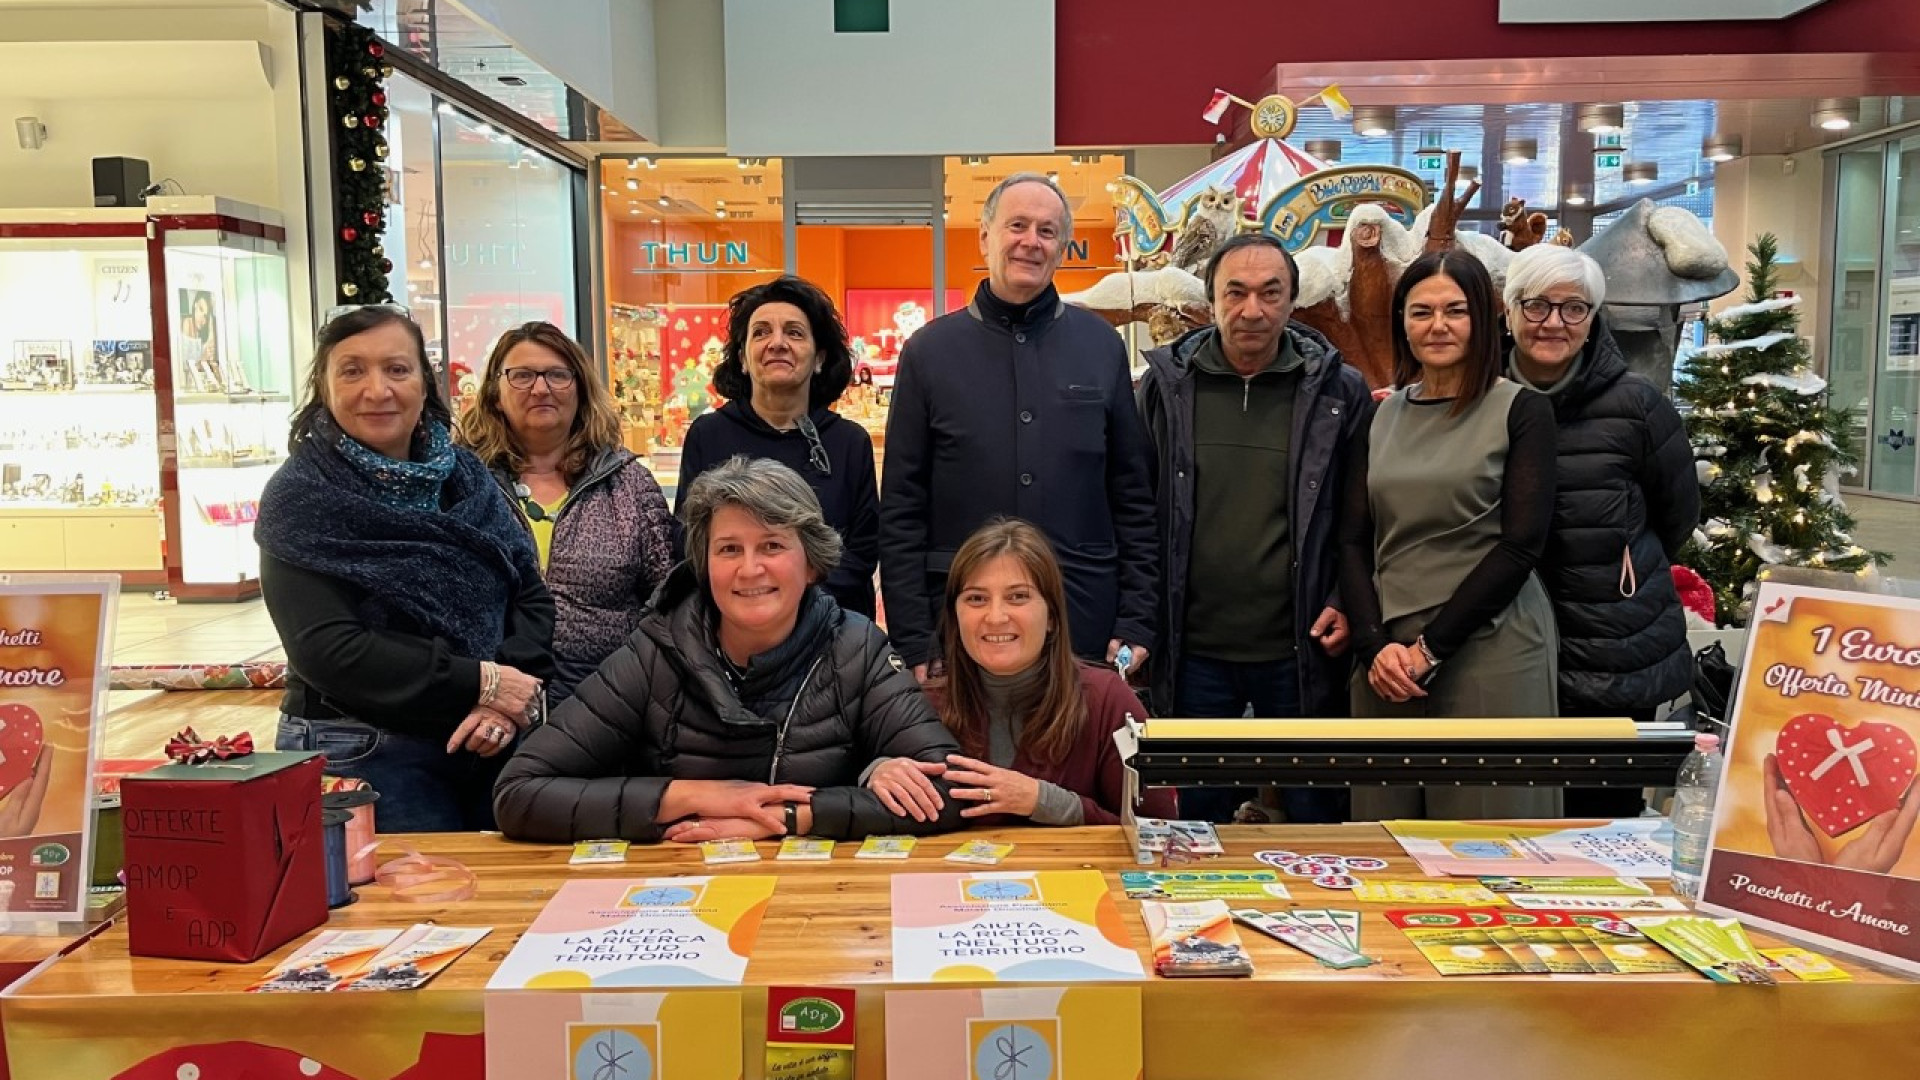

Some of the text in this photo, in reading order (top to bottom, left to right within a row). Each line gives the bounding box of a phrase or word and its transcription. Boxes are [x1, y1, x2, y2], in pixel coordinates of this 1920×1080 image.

[641, 241, 748, 264] THUN
[101, 265, 138, 274] CITIZEN
[0, 629, 41, 646] hetti
[1813, 626, 1920, 667] 1 Euro
[1764, 664, 1920, 709] Offerta Mini
[124, 808, 225, 834] OFFERTE
[128, 864, 198, 890] AMOP
[1729, 873, 1813, 909] Pacchetti
[188, 919, 237, 948] ADP
[563, 935, 706, 944] LA RICERCA
[939, 928, 1079, 939] LA RICERCA
[1009, 937, 1059, 946] TUO
[554, 952, 701, 962] TERRITORIO
[575, 944, 680, 953] NEL TUO
[939, 946, 1085, 956] TERRITORIO
[800, 1006, 828, 1023] ADP
